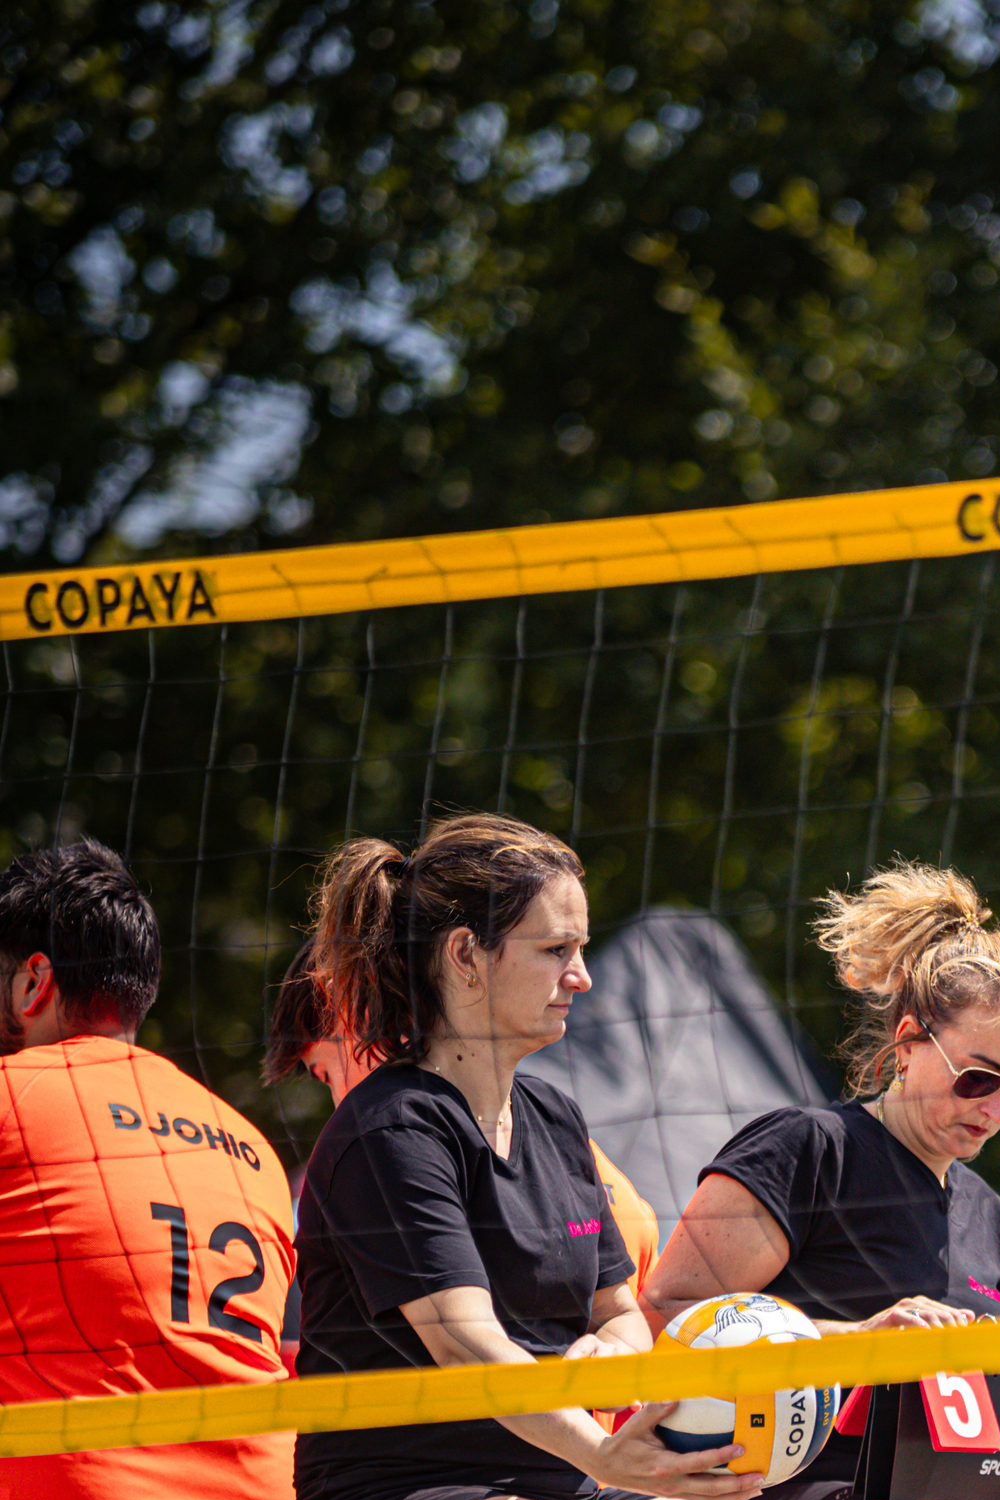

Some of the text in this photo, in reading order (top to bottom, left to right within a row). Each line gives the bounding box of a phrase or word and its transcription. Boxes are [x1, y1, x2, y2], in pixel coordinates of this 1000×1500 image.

[25, 570, 216, 631] COPAYA
[107, 1102, 261, 1172] DJOHIO
[150, 1201, 265, 1345] 12
[936, 1371, 982, 1438] 5
